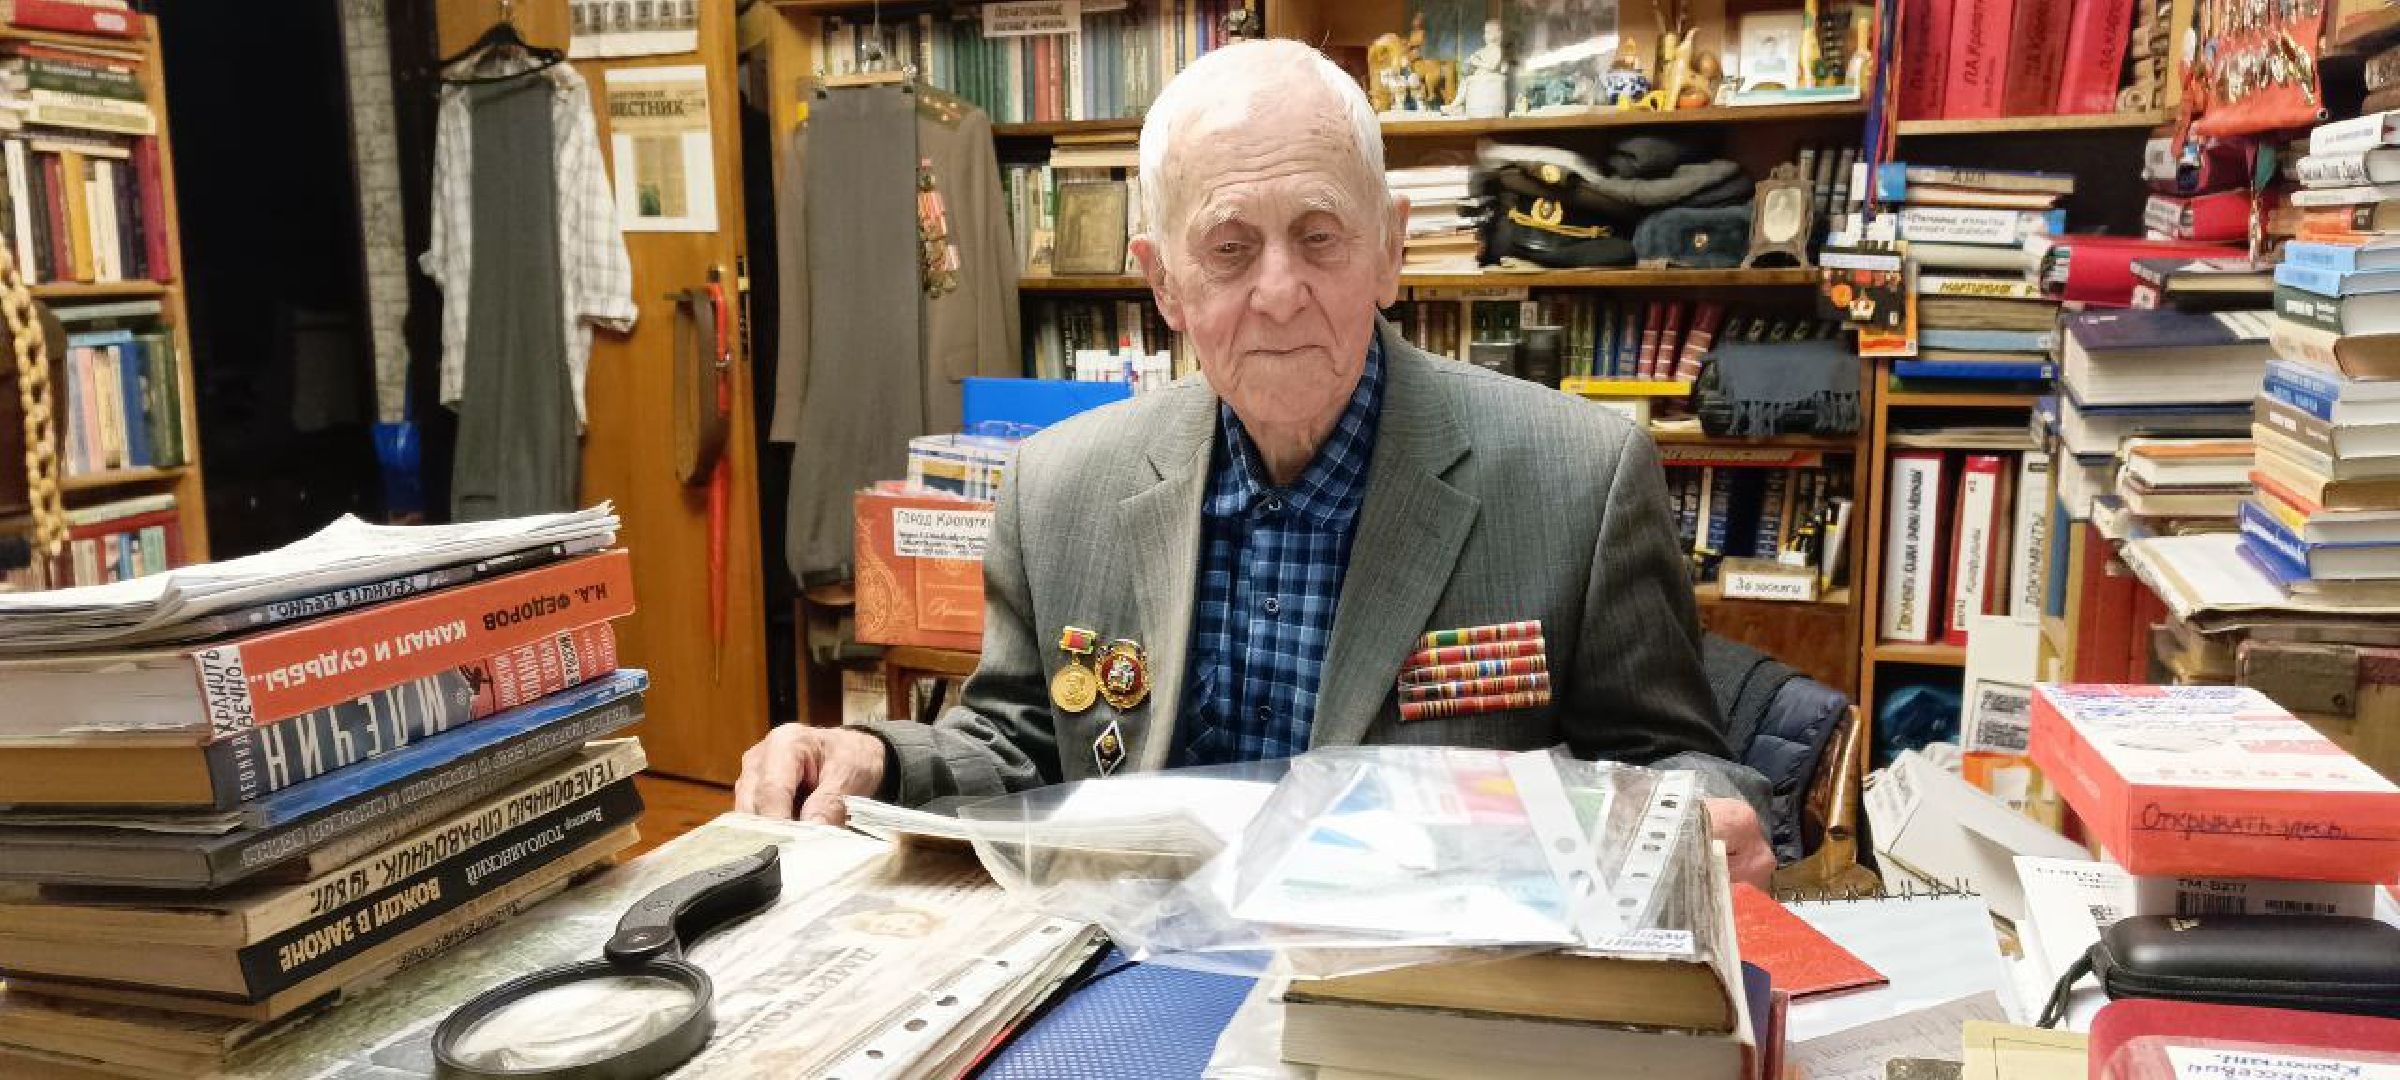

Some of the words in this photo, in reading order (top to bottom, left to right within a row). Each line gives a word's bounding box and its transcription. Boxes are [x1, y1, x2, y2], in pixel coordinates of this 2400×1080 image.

[610, 100, 684, 117] ВЕСТНИК
[481, 594, 571, 631] ФЕДОРОВ
[573, 582, 608, 604] Н.А.
[374, 641, 391, 662] И
[395, 619, 467, 655] КАНАЛ
[200, 649, 233, 736] ХРАНИТЬ
[225, 657, 253, 728] ВЕЧНО.
[260, 674, 449, 791] МЛЕЧИН
[231, 733, 257, 802] ЛЕОНИД
[2142, 801, 2272, 841] Открывать
[465, 826, 565, 887] ТОПОЛЯНСКИЙ
[358, 913, 372, 934] В
[373, 876, 441, 927] ВОЖДИ
[279, 920, 355, 973] ЗАКОНЕ
